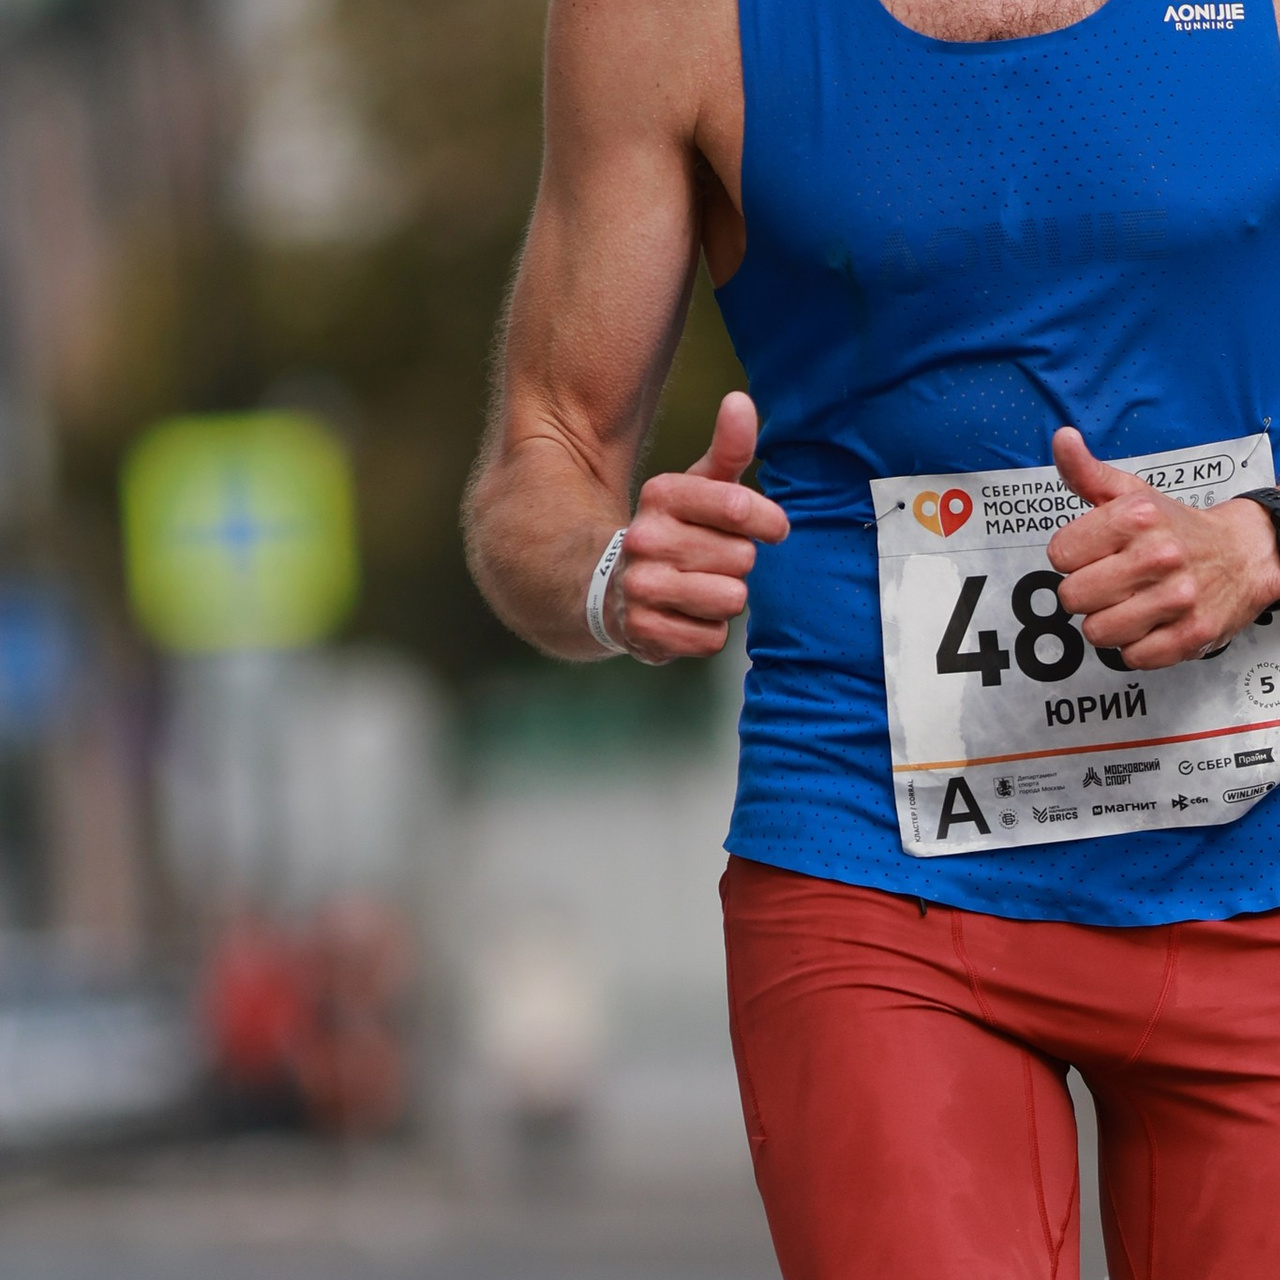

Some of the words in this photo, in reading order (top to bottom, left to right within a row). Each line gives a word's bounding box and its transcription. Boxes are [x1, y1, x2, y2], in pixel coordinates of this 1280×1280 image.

[1163, 3, 1245, 22] AONIJIE
[1175, 21, 1234, 31] RUNNING
[981, 478, 1070, 498] СБЕРПРАЙ
[1145, 468, 1185, 489] 42,2
[983, 495, 1093, 517] МОСКОВСК
[936, 570, 1232, 687] 48
[1260, 675, 1275, 694] 5
[1044, 683, 1147, 727] ЮРИЙ
[1103, 758, 1160, 775] МОСКОВСКИЙ
[1197, 757, 1232, 771] СБЕР
[1238, 753, 1267, 764] Прайм
[1105, 774, 1131, 786] СПОРТ
[908, 779, 916, 806] CORRAL
[1190, 796, 1208, 805] сбп
[1227, 786, 1264, 801] WINLINE
[1049, 811, 1079, 822] BRICS
[911, 811, 921, 842] КЛАСТЕР
